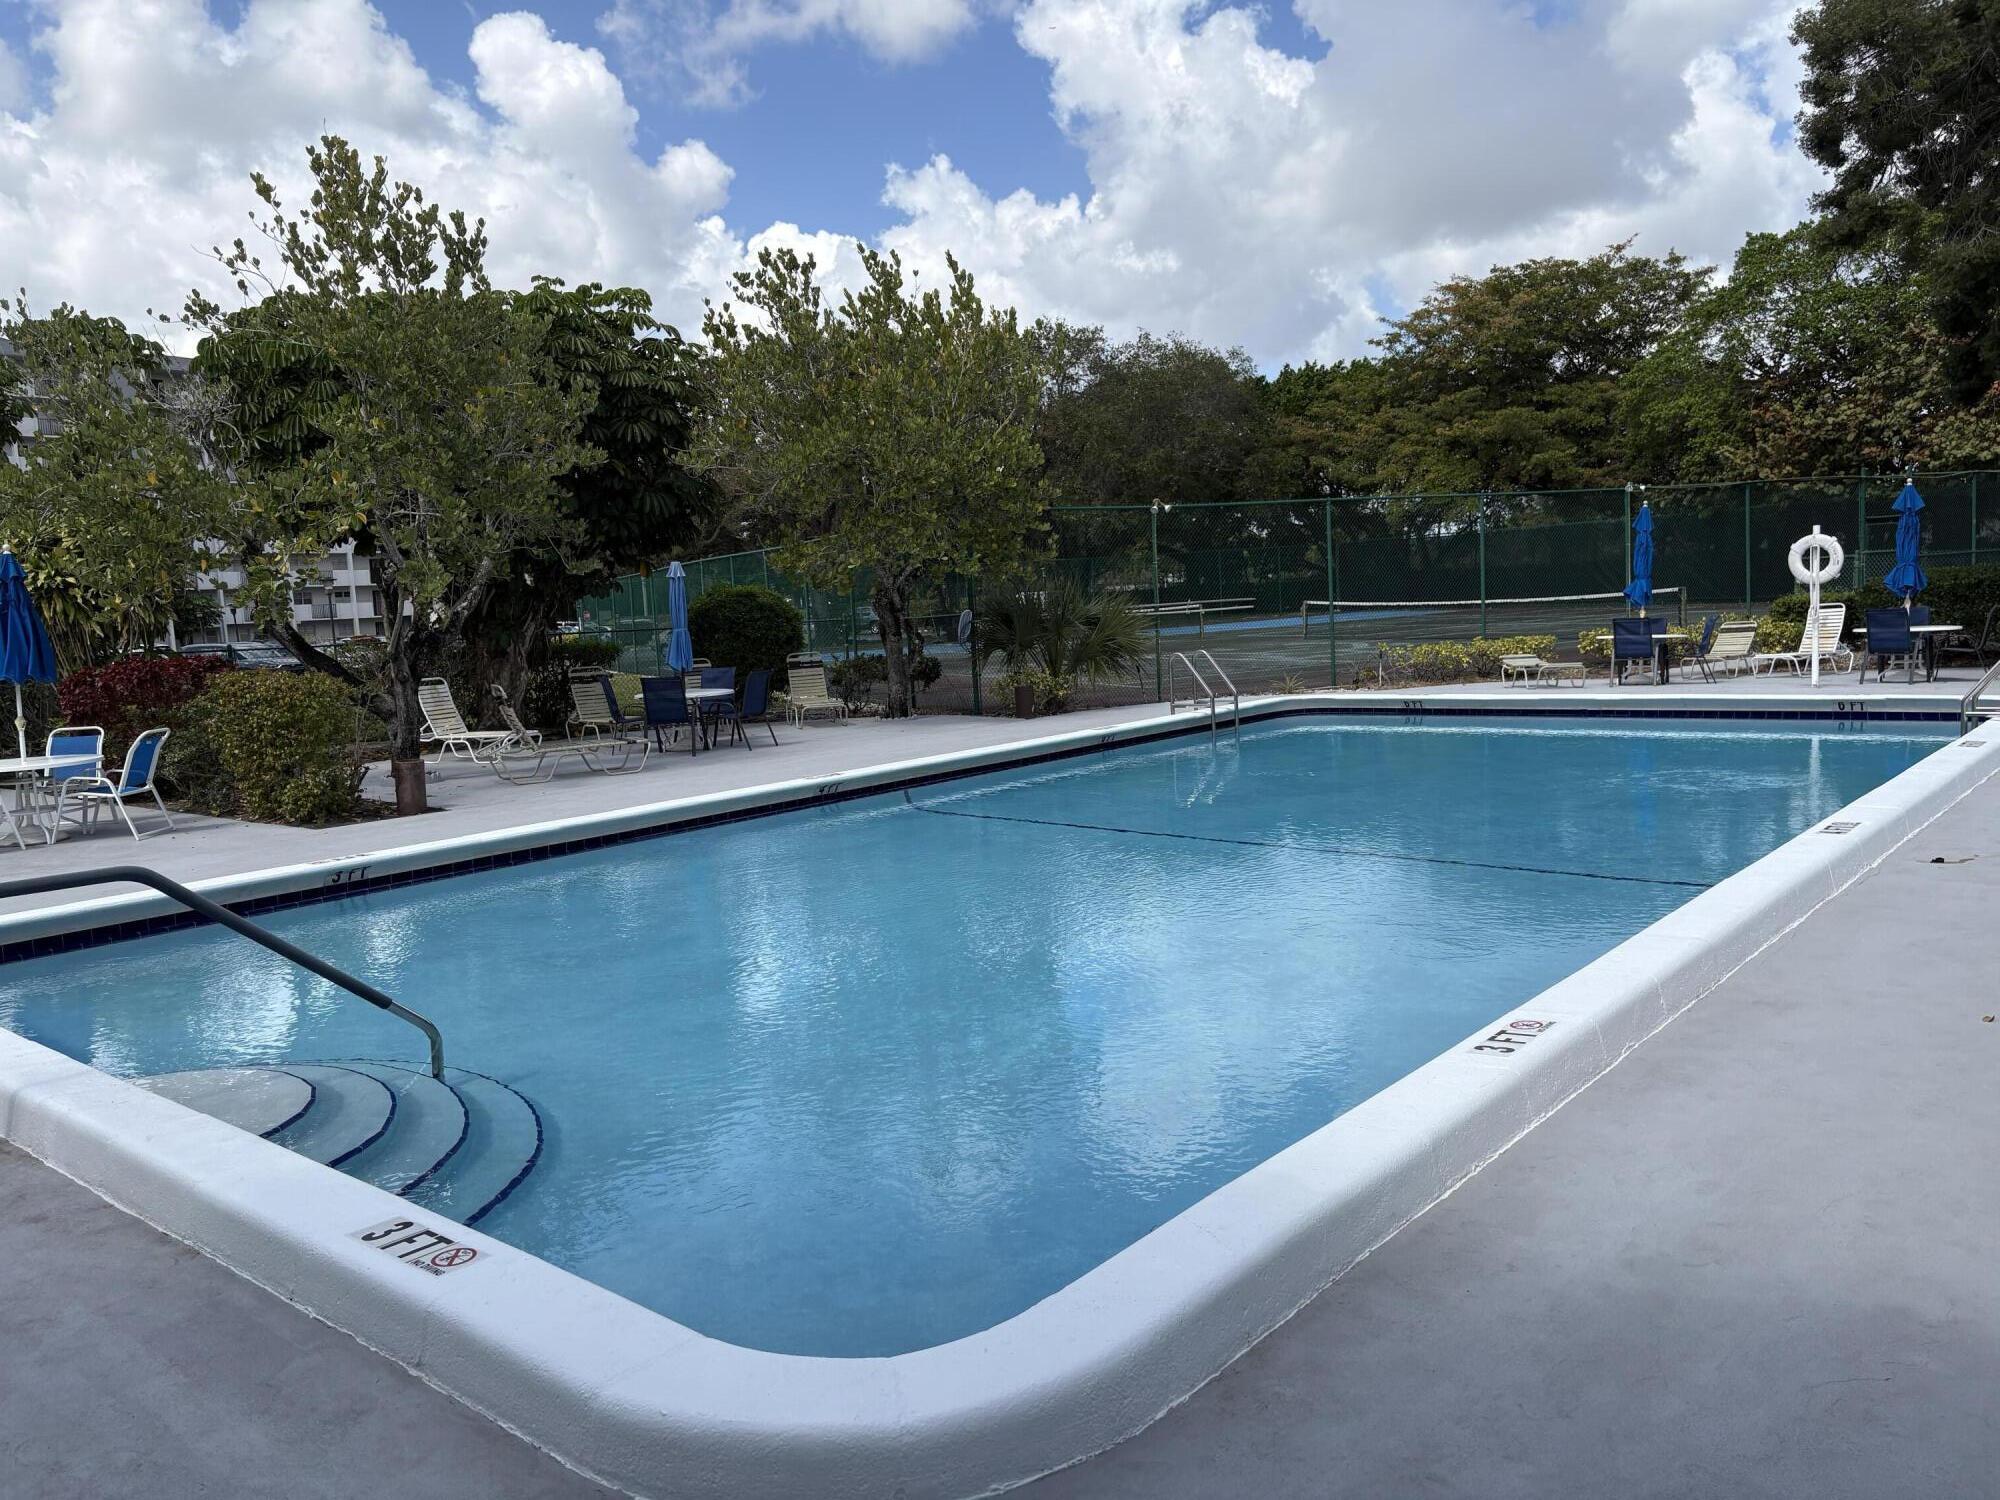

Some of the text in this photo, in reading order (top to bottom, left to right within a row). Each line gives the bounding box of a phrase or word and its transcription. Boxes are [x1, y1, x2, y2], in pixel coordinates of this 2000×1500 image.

[1850, 701, 1865, 711] FT
[1473, 1029, 1538, 1053] 3 FT
[361, 1221, 455, 1259] 3 FT
